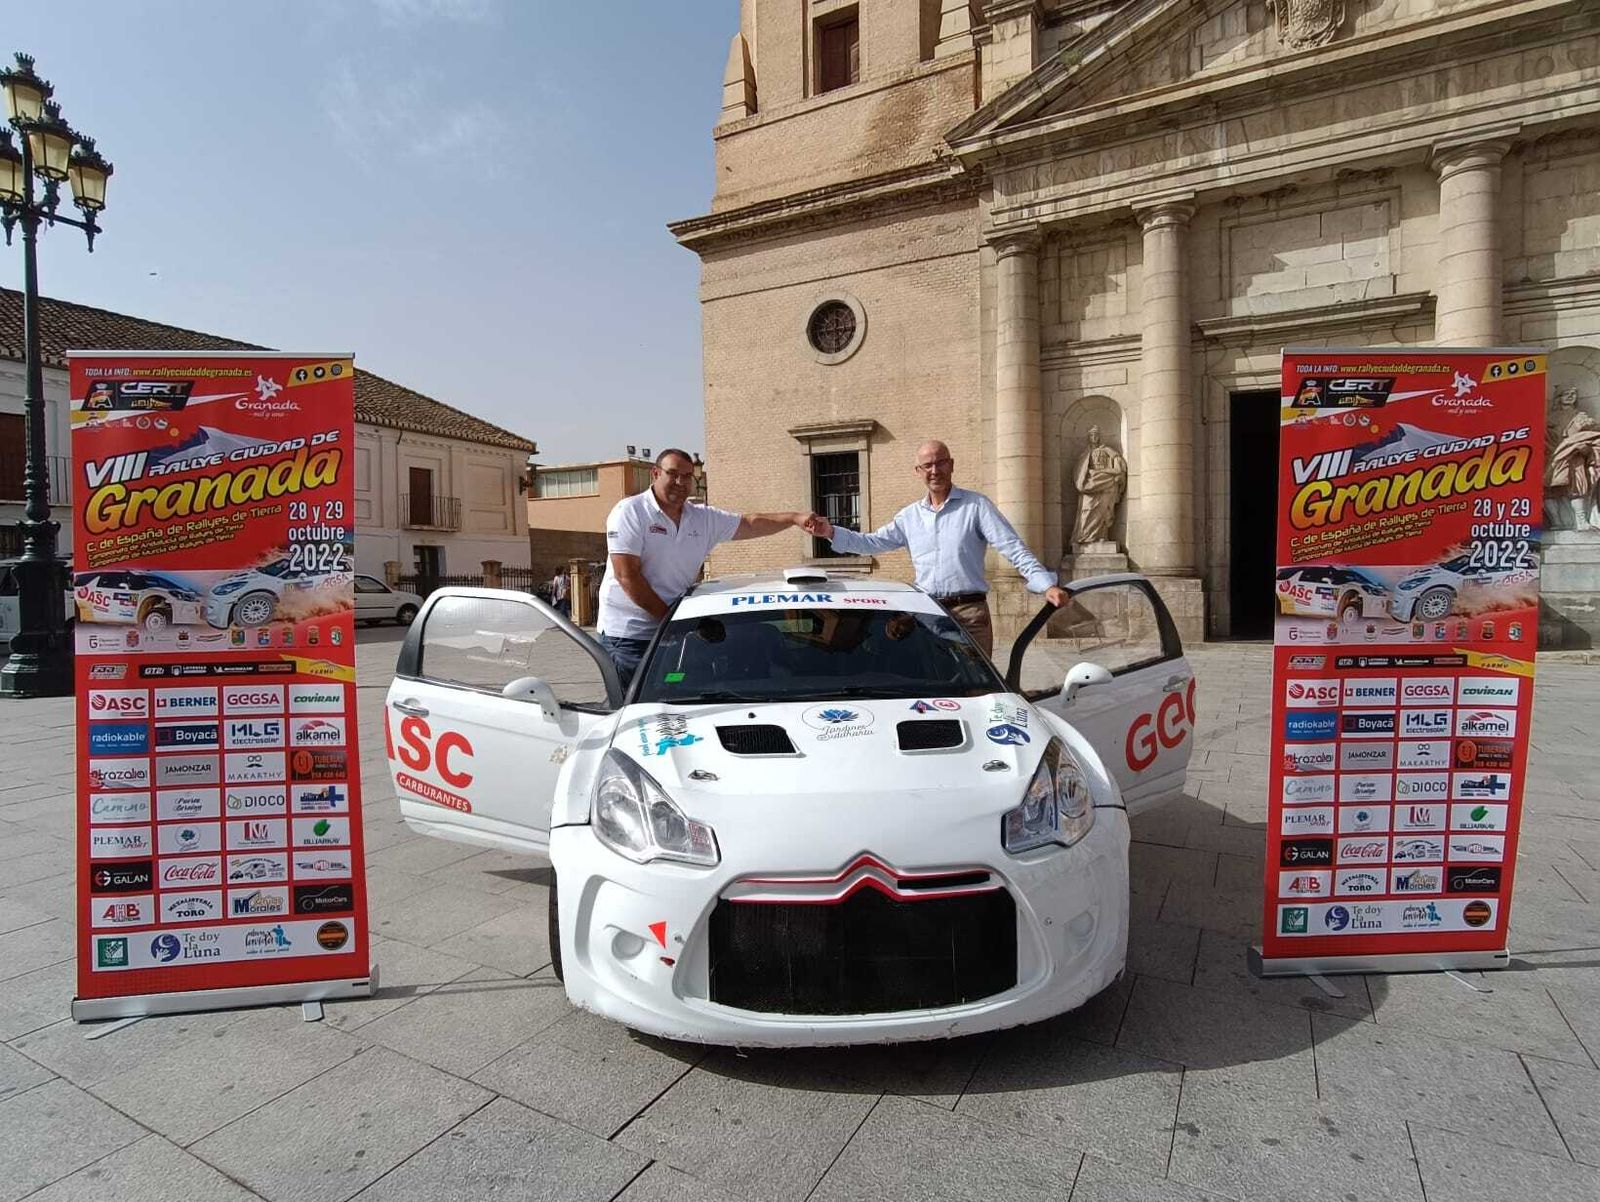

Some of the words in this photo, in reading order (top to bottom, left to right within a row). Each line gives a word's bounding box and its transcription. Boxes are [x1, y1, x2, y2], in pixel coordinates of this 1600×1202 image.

[85, 367, 102, 376] TODA
[104, 367, 113, 376] LA
[1296, 365, 1313, 373] TODA
[1314, 365, 1322, 373] LA
[120, 382, 189, 394] CERT
[1329, 379, 1391, 391] CERT
[235, 397, 301, 410] Granada
[1431, 394, 1494, 407] Granada
[85, 452, 147, 488] VIII
[149, 453, 225, 477] RALLYE
[229, 437, 305, 462] CIUDAD
[311, 429, 340, 445] DE
[1293, 449, 1353, 484] VIII
[1353, 450, 1418, 473] RALLYE
[1423, 434, 1495, 458] CIUDAD
[1498, 427, 1531, 443] DE
[85, 448, 343, 534] Granada
[1290, 445, 1530, 530] Granada
[289, 501, 307, 520] 28
[313, 505, 320, 523] y
[325, 501, 344, 519] 29
[1473, 498, 1491, 516] 28
[1496, 503, 1504, 520] y
[1510, 499, 1530, 516] 29
[100, 538, 114, 549] de
[117, 528, 163, 545] España
[167, 524, 183, 535] de
[187, 516, 229, 532] Rallyes
[232, 511, 247, 521] de
[250, 505, 282, 517] Tierra
[1303, 534, 1318, 544] de
[1321, 524, 1362, 540] España
[1364, 521, 1377, 531] de
[1380, 513, 1418, 528] Rallyes
[1421, 508, 1436, 518] de
[1438, 502, 1467, 514] Tierra
[1471, 521, 1531, 537] octubre
[288, 523, 345, 541] octubre
[288, 543, 345, 572] 2022
[1469, 540, 1530, 568] 2022
[88, 590, 111, 606] ASC
[1289, 585, 1313, 600] ASC
[732, 593, 835, 606] PLEMAR
[1305, 686, 1338, 699] ASC
[1355, 687, 1395, 697] BERNER
[106, 697, 146, 710] ASC
[170, 696, 217, 707] BERNER
[1288, 719, 1336, 729] radiokable
[1358, 718, 1393, 730] Boyacá
[1406, 712, 1447, 726] MLG
[232, 722, 280, 737] MLG
[1461, 720, 1509, 732] alkamel
[92, 731, 146, 743] radiokable
[176, 729, 217, 742] Boyacá
[296, 729, 340, 741] alkamel
[1348, 751, 1387, 759] JAMONZAR
[165, 764, 211, 774] JAMONZAR
[228, 772, 283, 781] MAKARTHY
[399, 774, 469, 812] CARBURANTES
[1412, 781, 1447, 792] DIOCO
[245, 794, 285, 808] DIOCO
[1285, 814, 1325, 824] PLEMAR
[94, 835, 142, 845] PLEMAR
[1300, 850, 1329, 859] GALAN
[1340, 842, 1386, 859] Coca-Cola
[164, 862, 219, 881] Coca-Cola
[113, 874, 149, 885] GALAN
[1348, 884, 1372, 892] TORO
[176, 909, 205, 917] TORO
[1352, 905, 1363, 915] Te
[1365, 905, 1383, 916] doy
[1351, 918, 1382, 929] Luna
[183, 933, 195, 943] Te
[199, 931, 221, 943] doy
[183, 947, 221, 959] Luna
